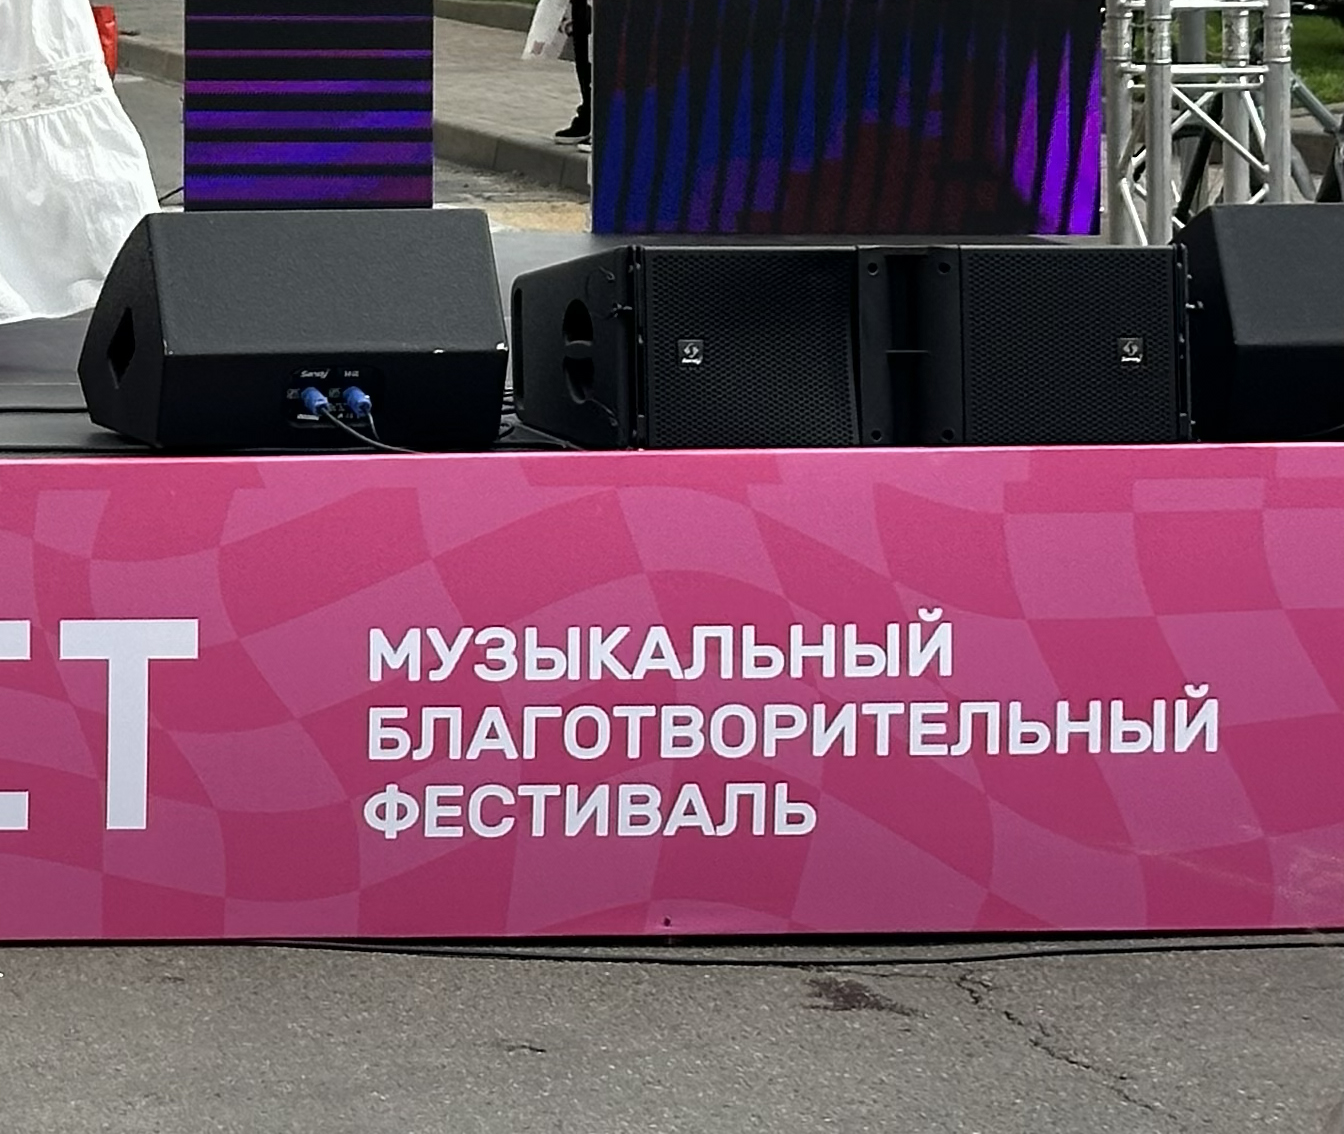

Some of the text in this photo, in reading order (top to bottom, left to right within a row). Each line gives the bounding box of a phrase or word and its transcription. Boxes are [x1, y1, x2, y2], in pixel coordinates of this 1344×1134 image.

[369, 608, 952, 682] МУЗЫКАЛЬНЫЙ
[368, 684, 1219, 761] БЛАГОТВОРИТЕЛЬНЫЙ
[363, 783, 817, 839] ФЕСТИВАЛЬ
